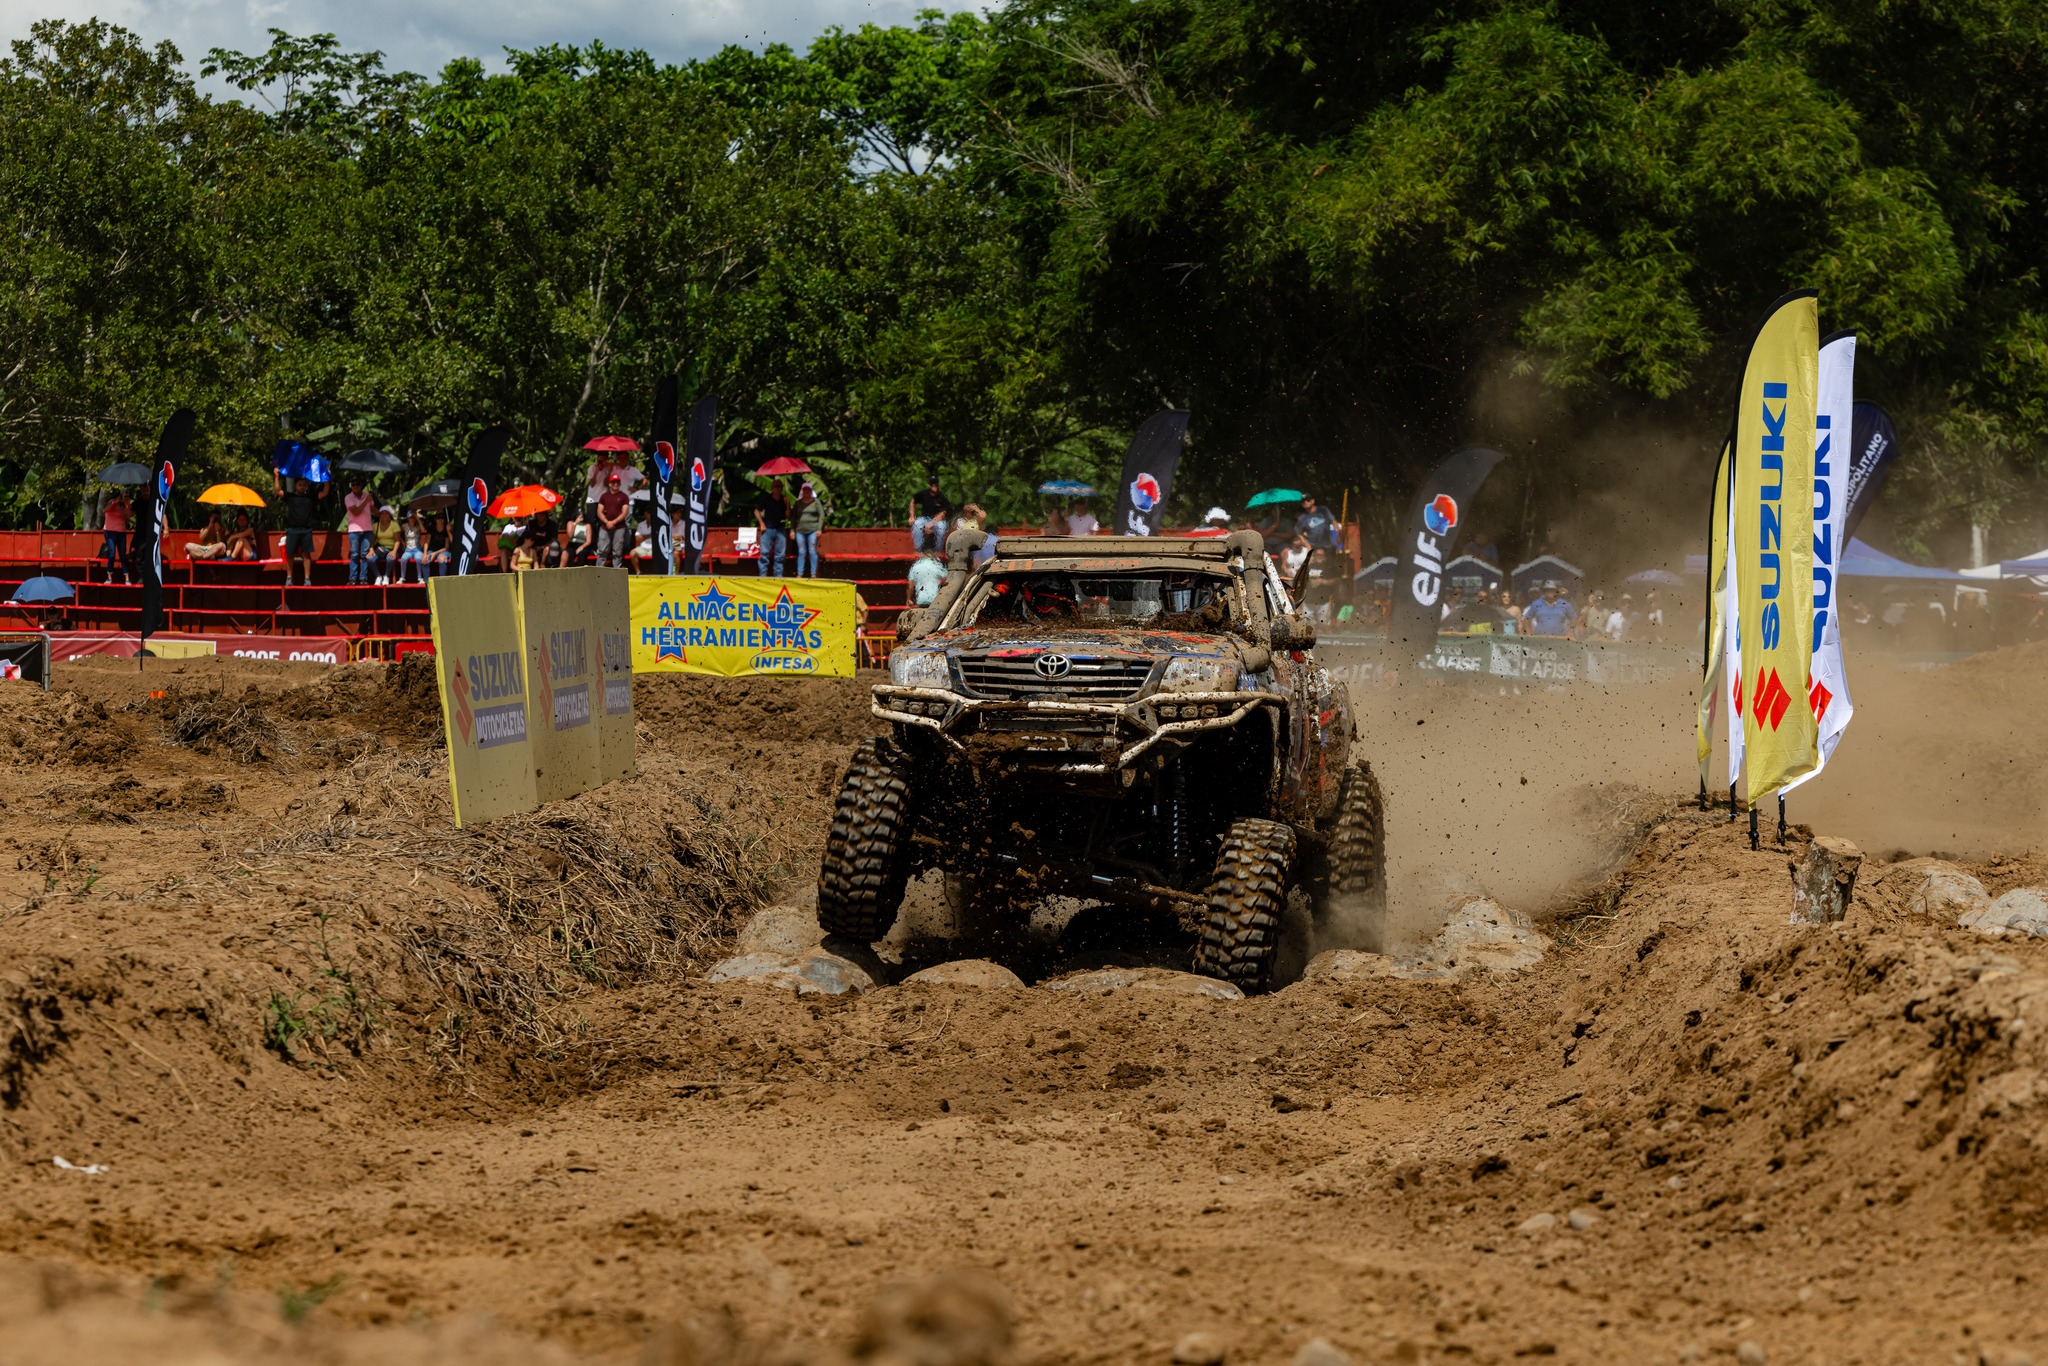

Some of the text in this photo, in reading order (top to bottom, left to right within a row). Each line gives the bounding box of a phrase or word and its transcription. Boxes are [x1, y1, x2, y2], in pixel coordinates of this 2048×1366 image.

[690, 491, 705, 550] elf
[1760, 383, 1787, 650] SUZUKI
[1412, 531, 1442, 606] elf
[657, 601, 805, 623] ALMACEN DE
[551, 627, 588, 680] SUZUKI
[641, 627, 822, 648] HERRAMIENTAS
[468, 651, 522, 701] SUZUKI
[754, 656, 813, 669] INFESA
[1430, 655, 1481, 671] AFISE
[475, 709, 525, 741] MOTOCICLETAS
